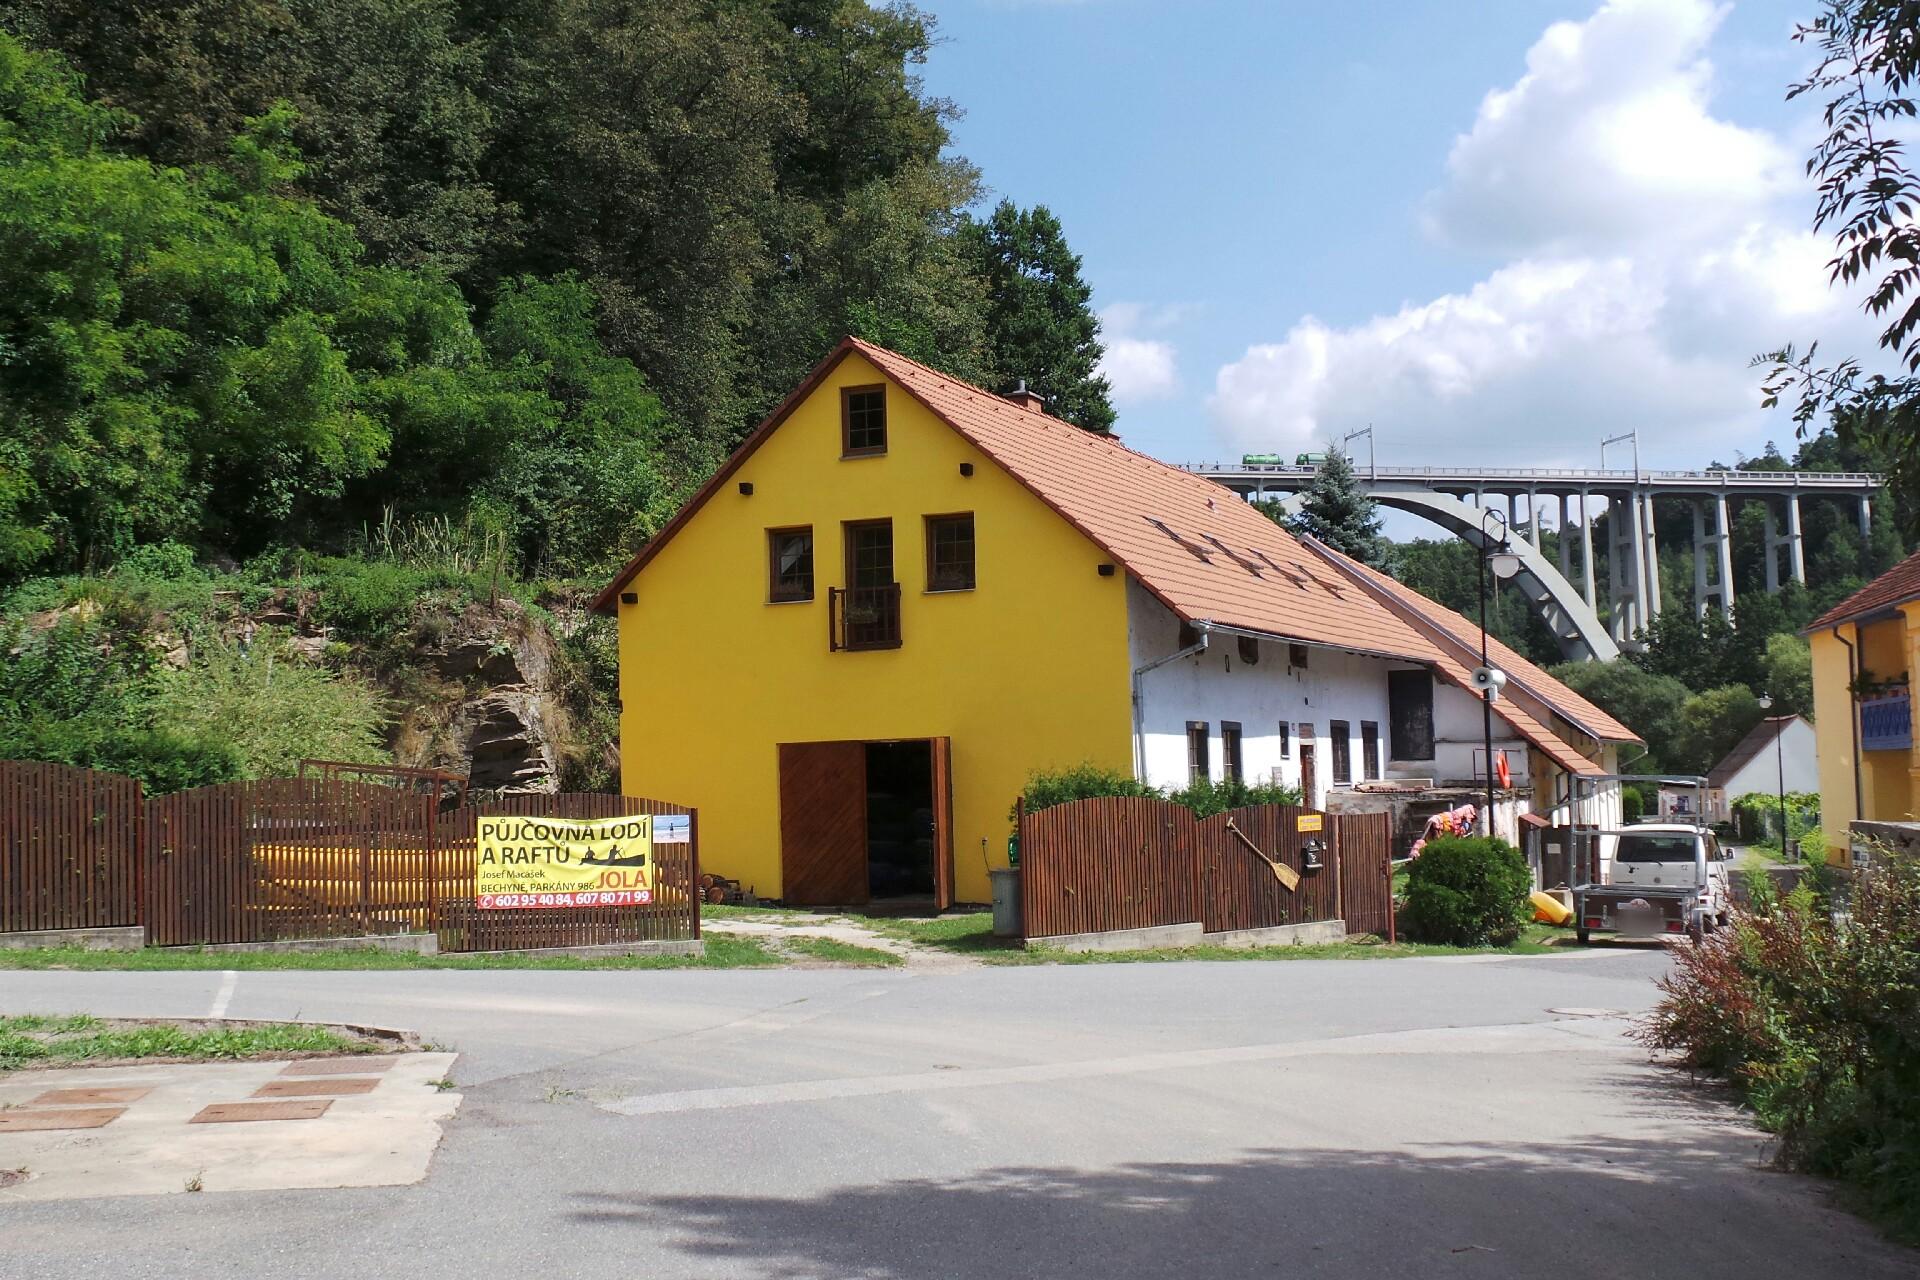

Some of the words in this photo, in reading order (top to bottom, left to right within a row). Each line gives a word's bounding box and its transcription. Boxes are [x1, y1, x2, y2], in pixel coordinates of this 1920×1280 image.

[482, 847, 496, 864] A
[501, 841, 570, 864] RAFTŮ
[482, 870, 506, 879] Josef
[596, 870, 647, 889] JOLA
[577, 882, 595, 891] 986
[496, 895, 519, 907] 602
[521, 894, 537, 906] 95
[538, 894, 554, 905] 40
[576, 893, 598, 904] 607
[600, 892, 616, 904] 80
[617, 892, 631, 903] 71
[633, 891, 650, 902] 99
